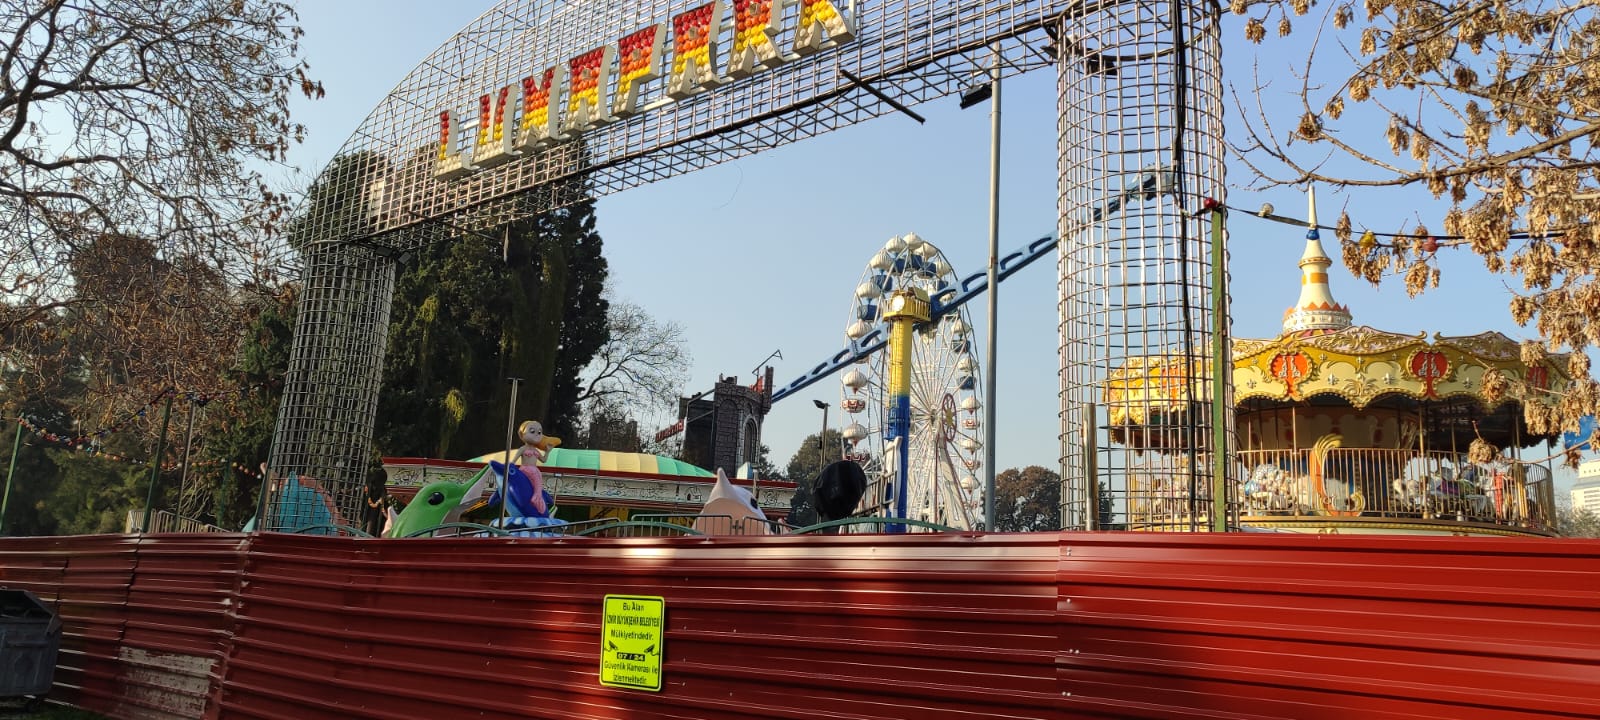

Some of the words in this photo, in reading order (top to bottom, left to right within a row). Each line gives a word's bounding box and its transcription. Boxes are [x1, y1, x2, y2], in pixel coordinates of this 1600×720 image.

[432, 0, 857, 181] LUNAPARK
[622, 602, 631, 611] Bu
[631, 602, 645, 612] Alan
